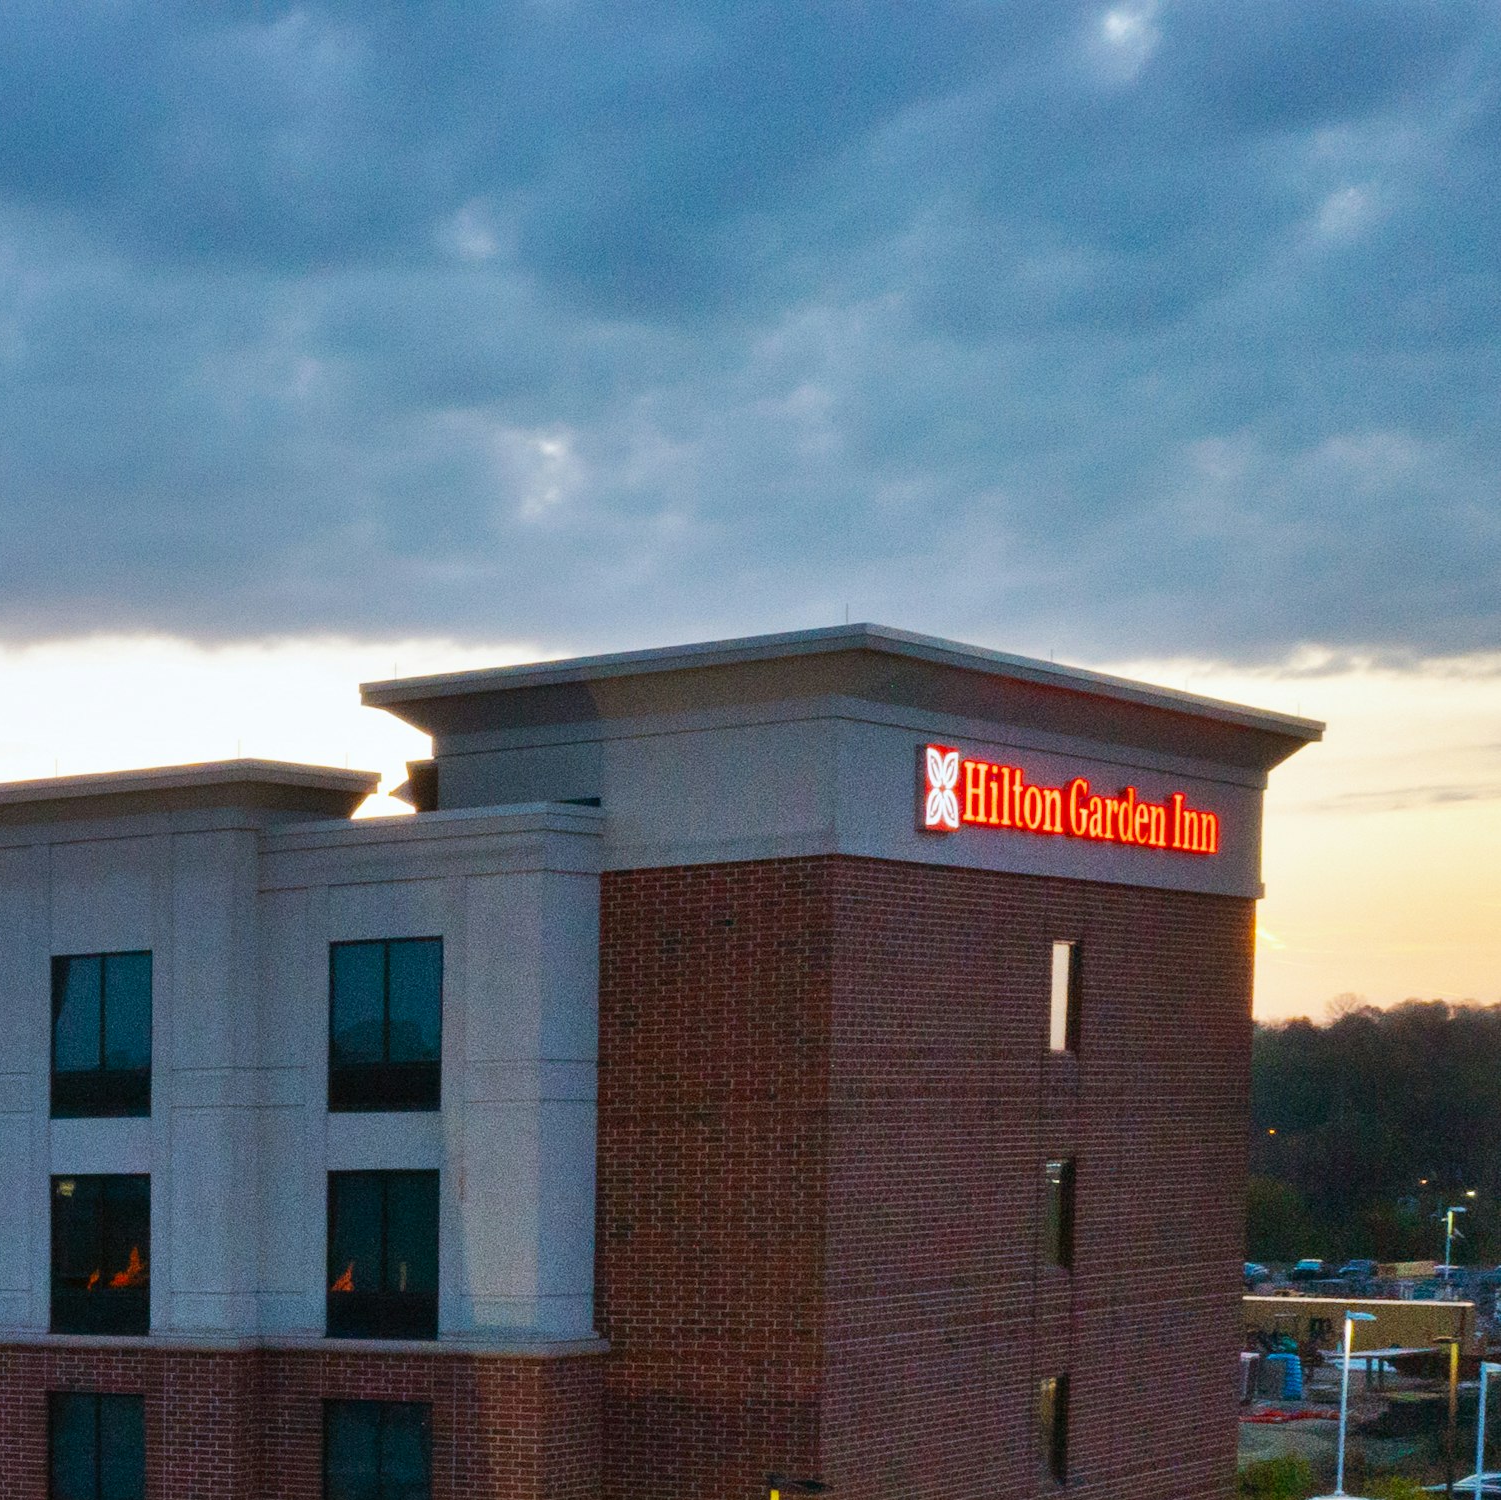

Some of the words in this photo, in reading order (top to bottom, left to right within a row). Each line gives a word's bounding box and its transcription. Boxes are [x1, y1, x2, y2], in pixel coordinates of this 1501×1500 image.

[963, 760, 1063, 833] Hilton
[1069, 778, 1166, 846] Garden
[1172, 793, 1219, 853] Inn
